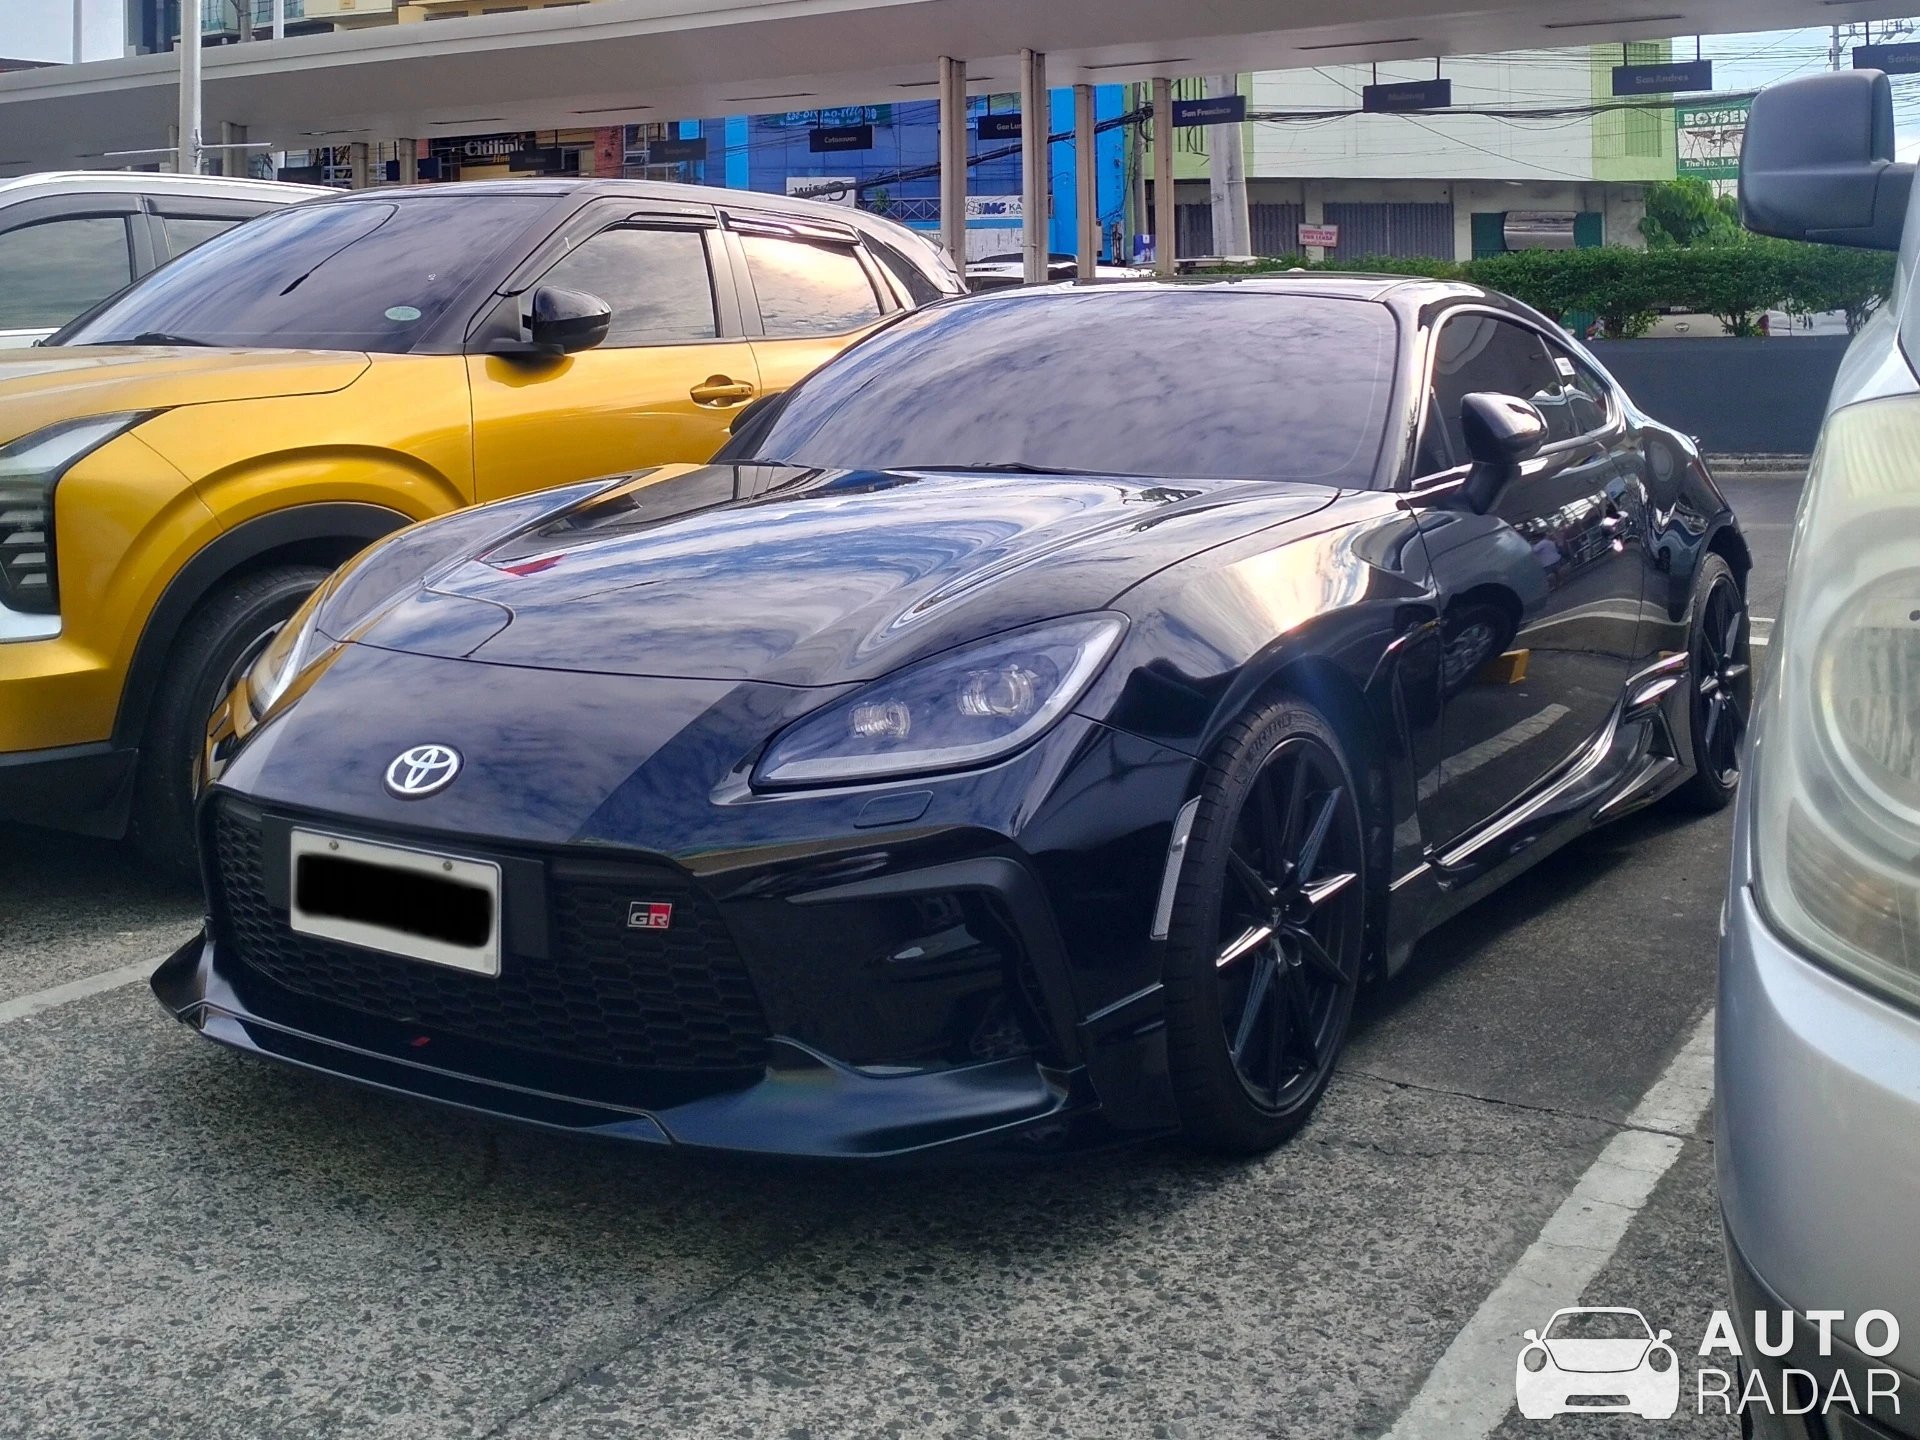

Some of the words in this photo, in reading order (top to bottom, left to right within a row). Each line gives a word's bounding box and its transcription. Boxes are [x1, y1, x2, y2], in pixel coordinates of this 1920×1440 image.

[1635, 76, 1654, 84] San
[1655, 73, 1689, 82] Andres
[1181, 110, 1197, 118] San
[1197, 107, 1232, 117] Francisco
[1683, 109, 1749, 126] BOYSEN
[464, 138, 525, 157] Citilink
[1685, 160, 1701, 168] The
[630, 912, 668, 926] GR
